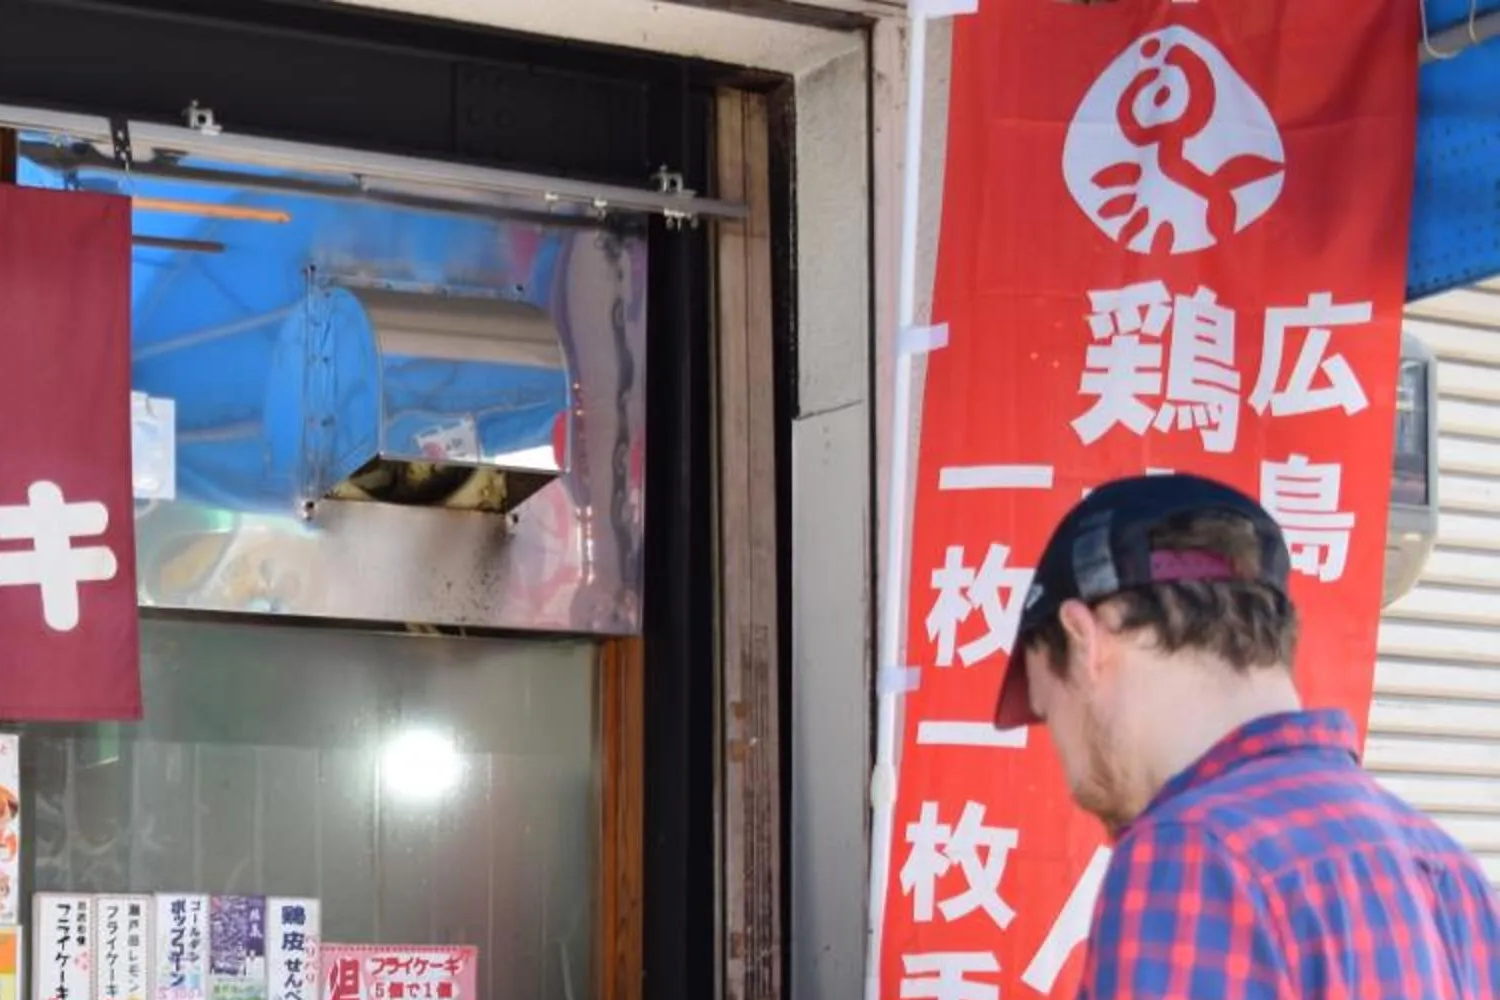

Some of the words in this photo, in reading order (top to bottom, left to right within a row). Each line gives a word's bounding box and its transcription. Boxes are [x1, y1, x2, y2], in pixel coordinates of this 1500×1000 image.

[105, 905, 120, 999] フライケーキ
[371, 956, 461, 977] フライケーキ
